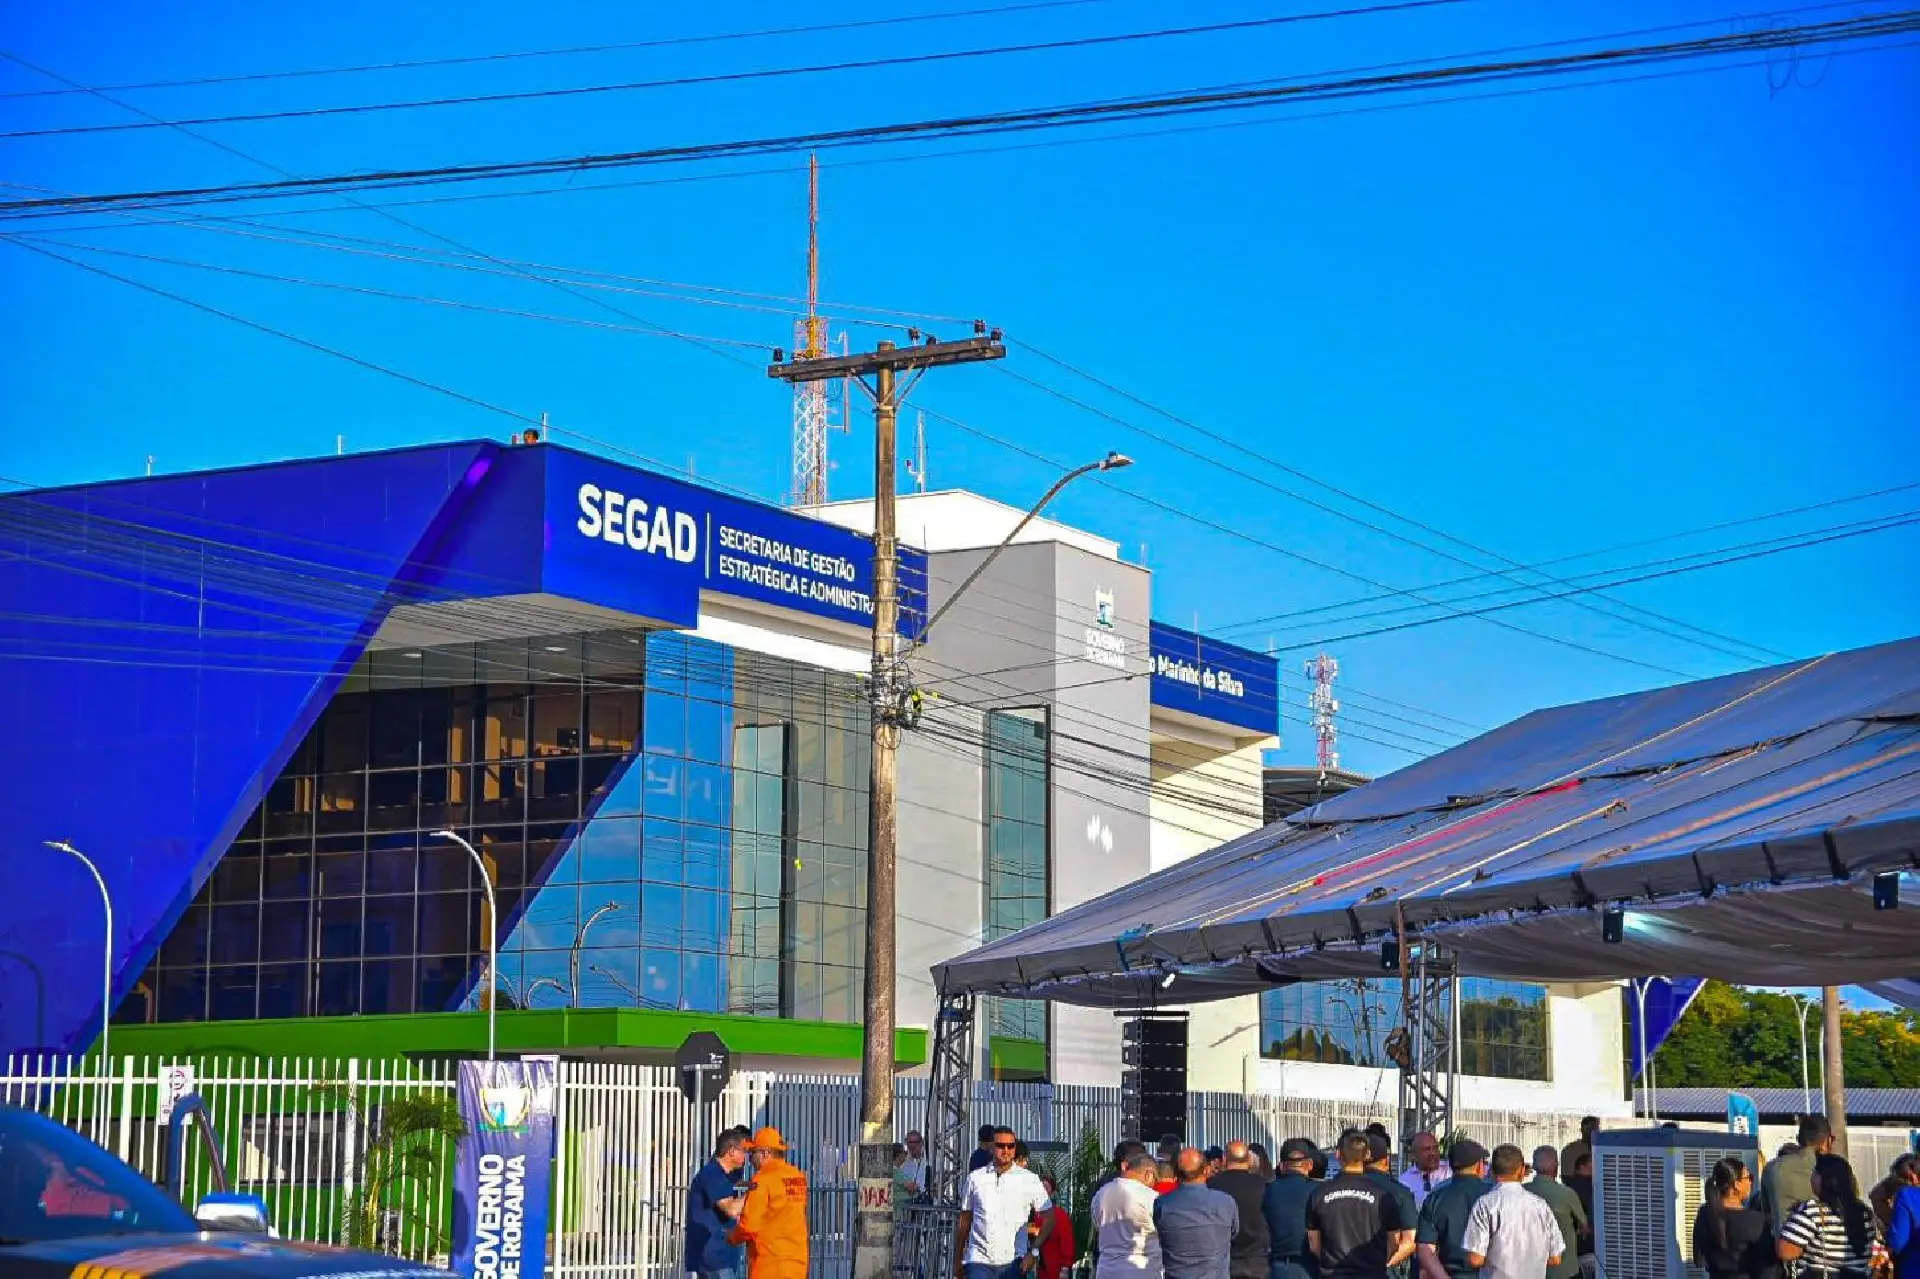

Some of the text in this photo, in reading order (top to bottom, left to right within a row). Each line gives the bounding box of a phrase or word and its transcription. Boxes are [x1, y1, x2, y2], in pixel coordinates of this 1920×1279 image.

[578, 483, 697, 563] SEGAD
[719, 525, 856, 582] SECRETARIA DE GESTÃO
[719, 554, 799, 595] ESTRATÉGICA
[801, 577, 808, 598] E
[1158, 654, 1201, 686] Marinho
[1218, 671, 1244, 697] Silva
[503, 1154, 526, 1257] RORAIMA
